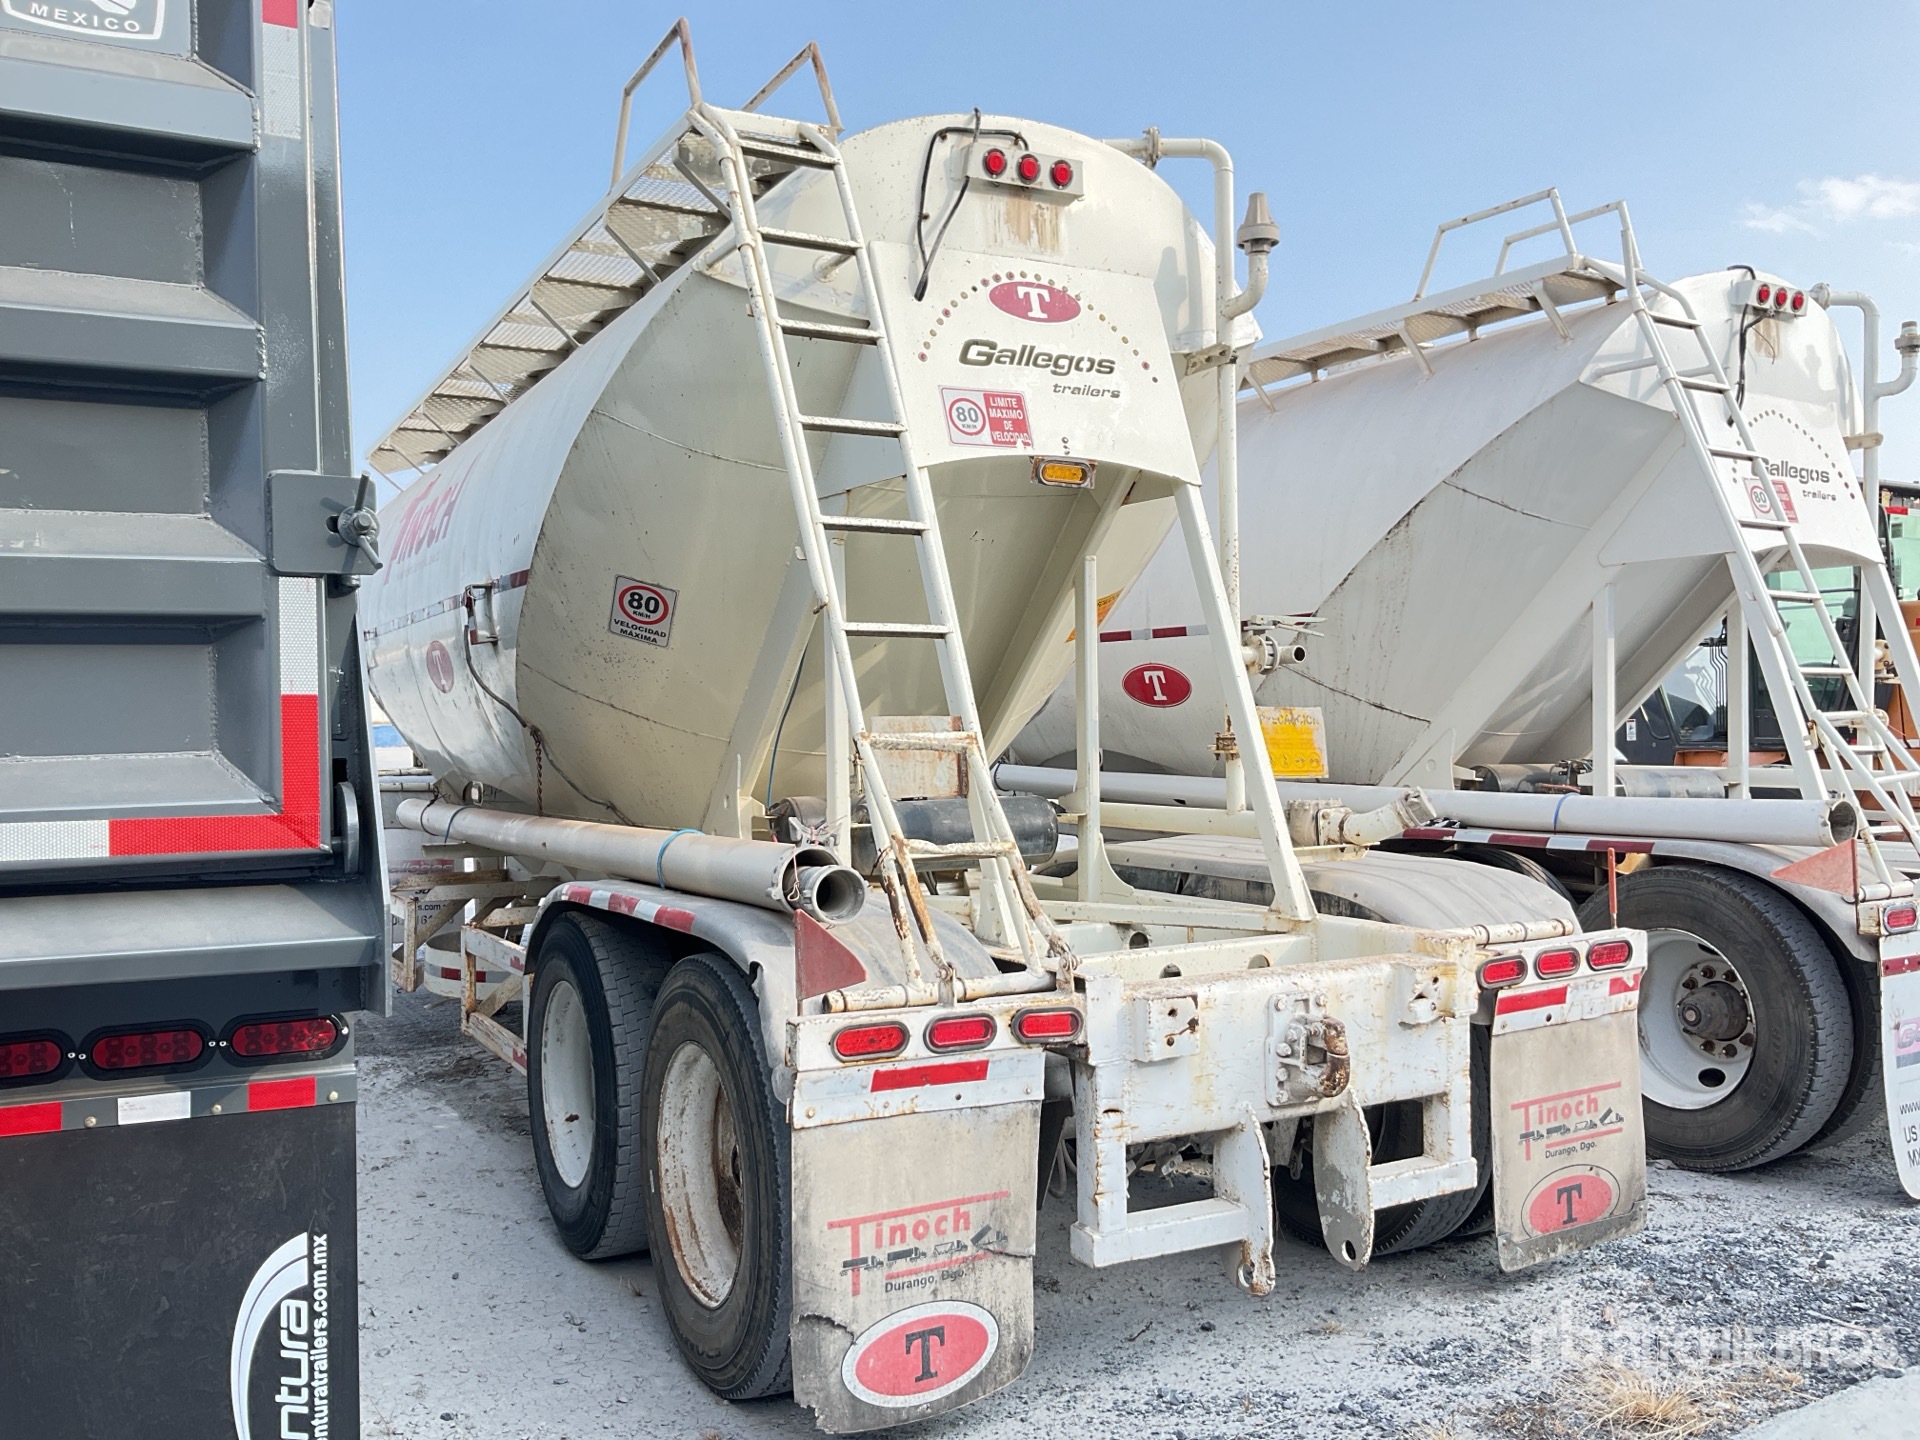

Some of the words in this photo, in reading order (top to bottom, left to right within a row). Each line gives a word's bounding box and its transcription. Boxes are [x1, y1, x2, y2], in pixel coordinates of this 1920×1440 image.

[30, 2, 141, 32] MEXICO
[1016, 285, 1050, 319] T
[958, 338, 1116, 377] Gallegos
[1052, 382, 1121, 399] trailers
[989, 396, 1018, 408] LIMITE
[956, 406, 979, 423] 80
[989, 408, 1024, 420] MAXIMO
[1003, 420, 1014, 431] DE
[1753, 490, 1767, 503] 80
[1802, 489, 1837, 501] trailers
[628, 591, 660, 614] 80
[632, 610, 651, 619] KM/H
[613, 618, 667, 638] VELOCIDAD
[1143, 670, 1168, 701] T
[1545, 1146, 1578, 1159] Durango,
[1580, 1140, 1597, 1152] Dgo.
[1557, 1183, 1582, 1225] T
[885, 1275, 938, 1293] Durango,
[310, 1233, 328, 1440] nturatrailers.com.mx
[905, 1325, 945, 1383] T
[275, 1299, 309, 1440] ntura
